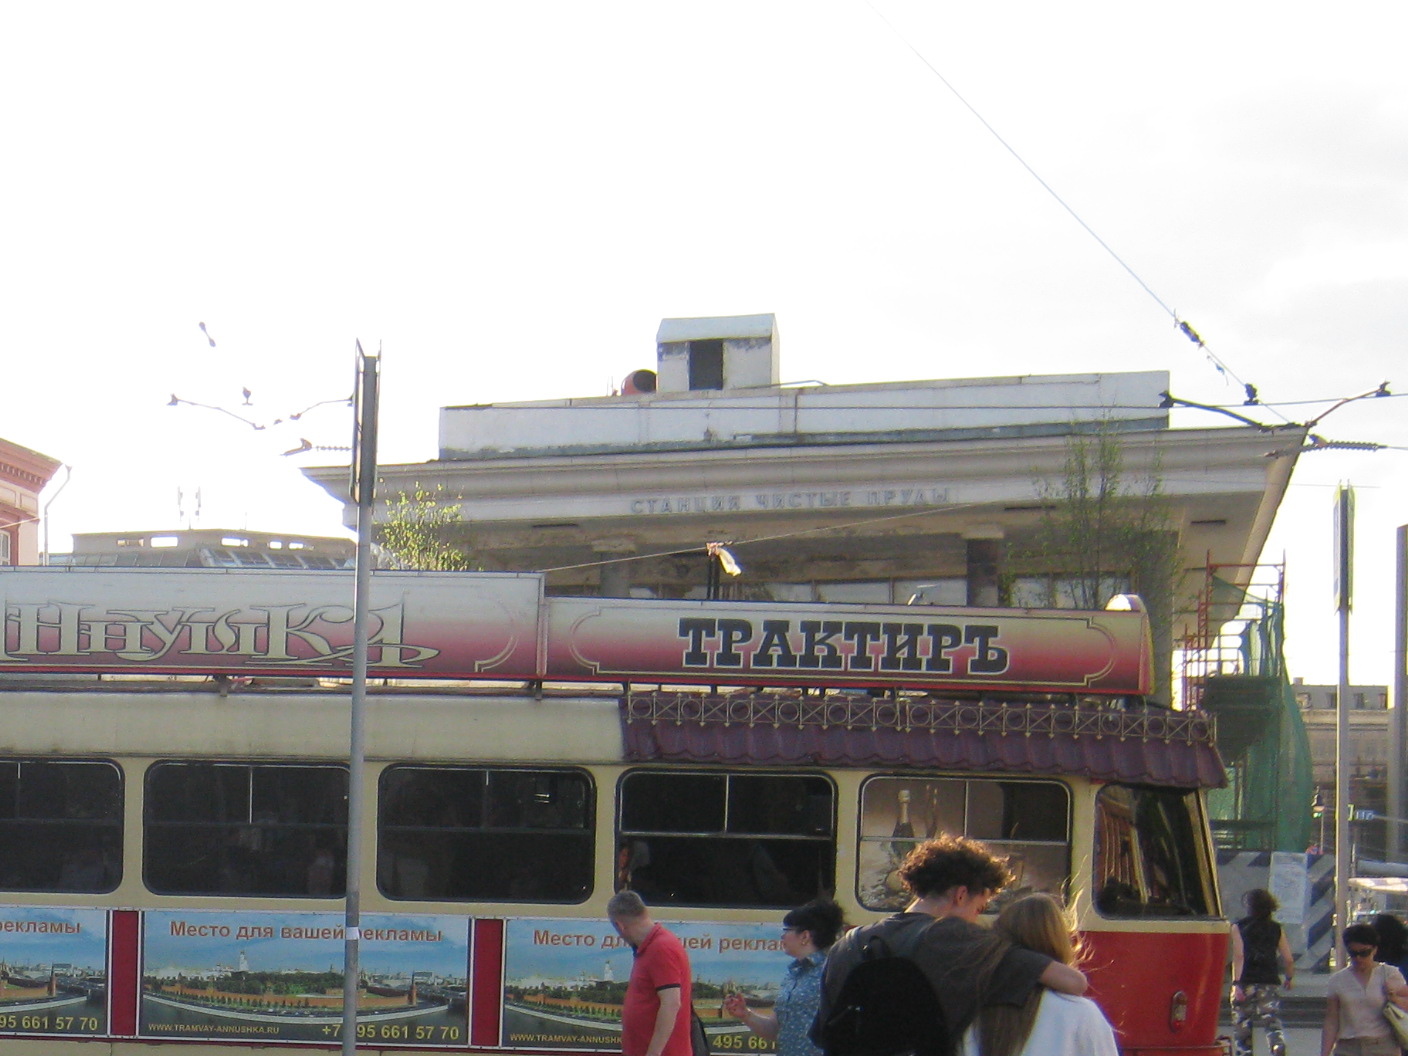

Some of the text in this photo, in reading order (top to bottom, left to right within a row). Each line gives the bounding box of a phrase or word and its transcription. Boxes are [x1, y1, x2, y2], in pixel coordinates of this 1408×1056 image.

[755, 491, 852, 509] ЧИСТЫЕ
[866, 487, 950, 506] ПРУДЫ
[678, 617, 1009, 675] ТРАКТИРЪ
[169, 920, 442, 943] Место для вашей екламы
[534, 929, 632, 950] Место дл
[719, 937, 786, 954] рекла
[21, 1016, 49, 1030] 661
[55, 1016, 74, 1030] 57
[79, 1017, 98, 1031] 70
[148, 1023, 280, 1035] WWW.TRAMVAY-ANNUSHKA.RU
[322, 1024, 460, 1040] +7 95 661 57 70
[510, 1033, 623, 1044] WWW.TRAMVAY-ANNUSHK
[712, 1034, 743, 1049] 495
